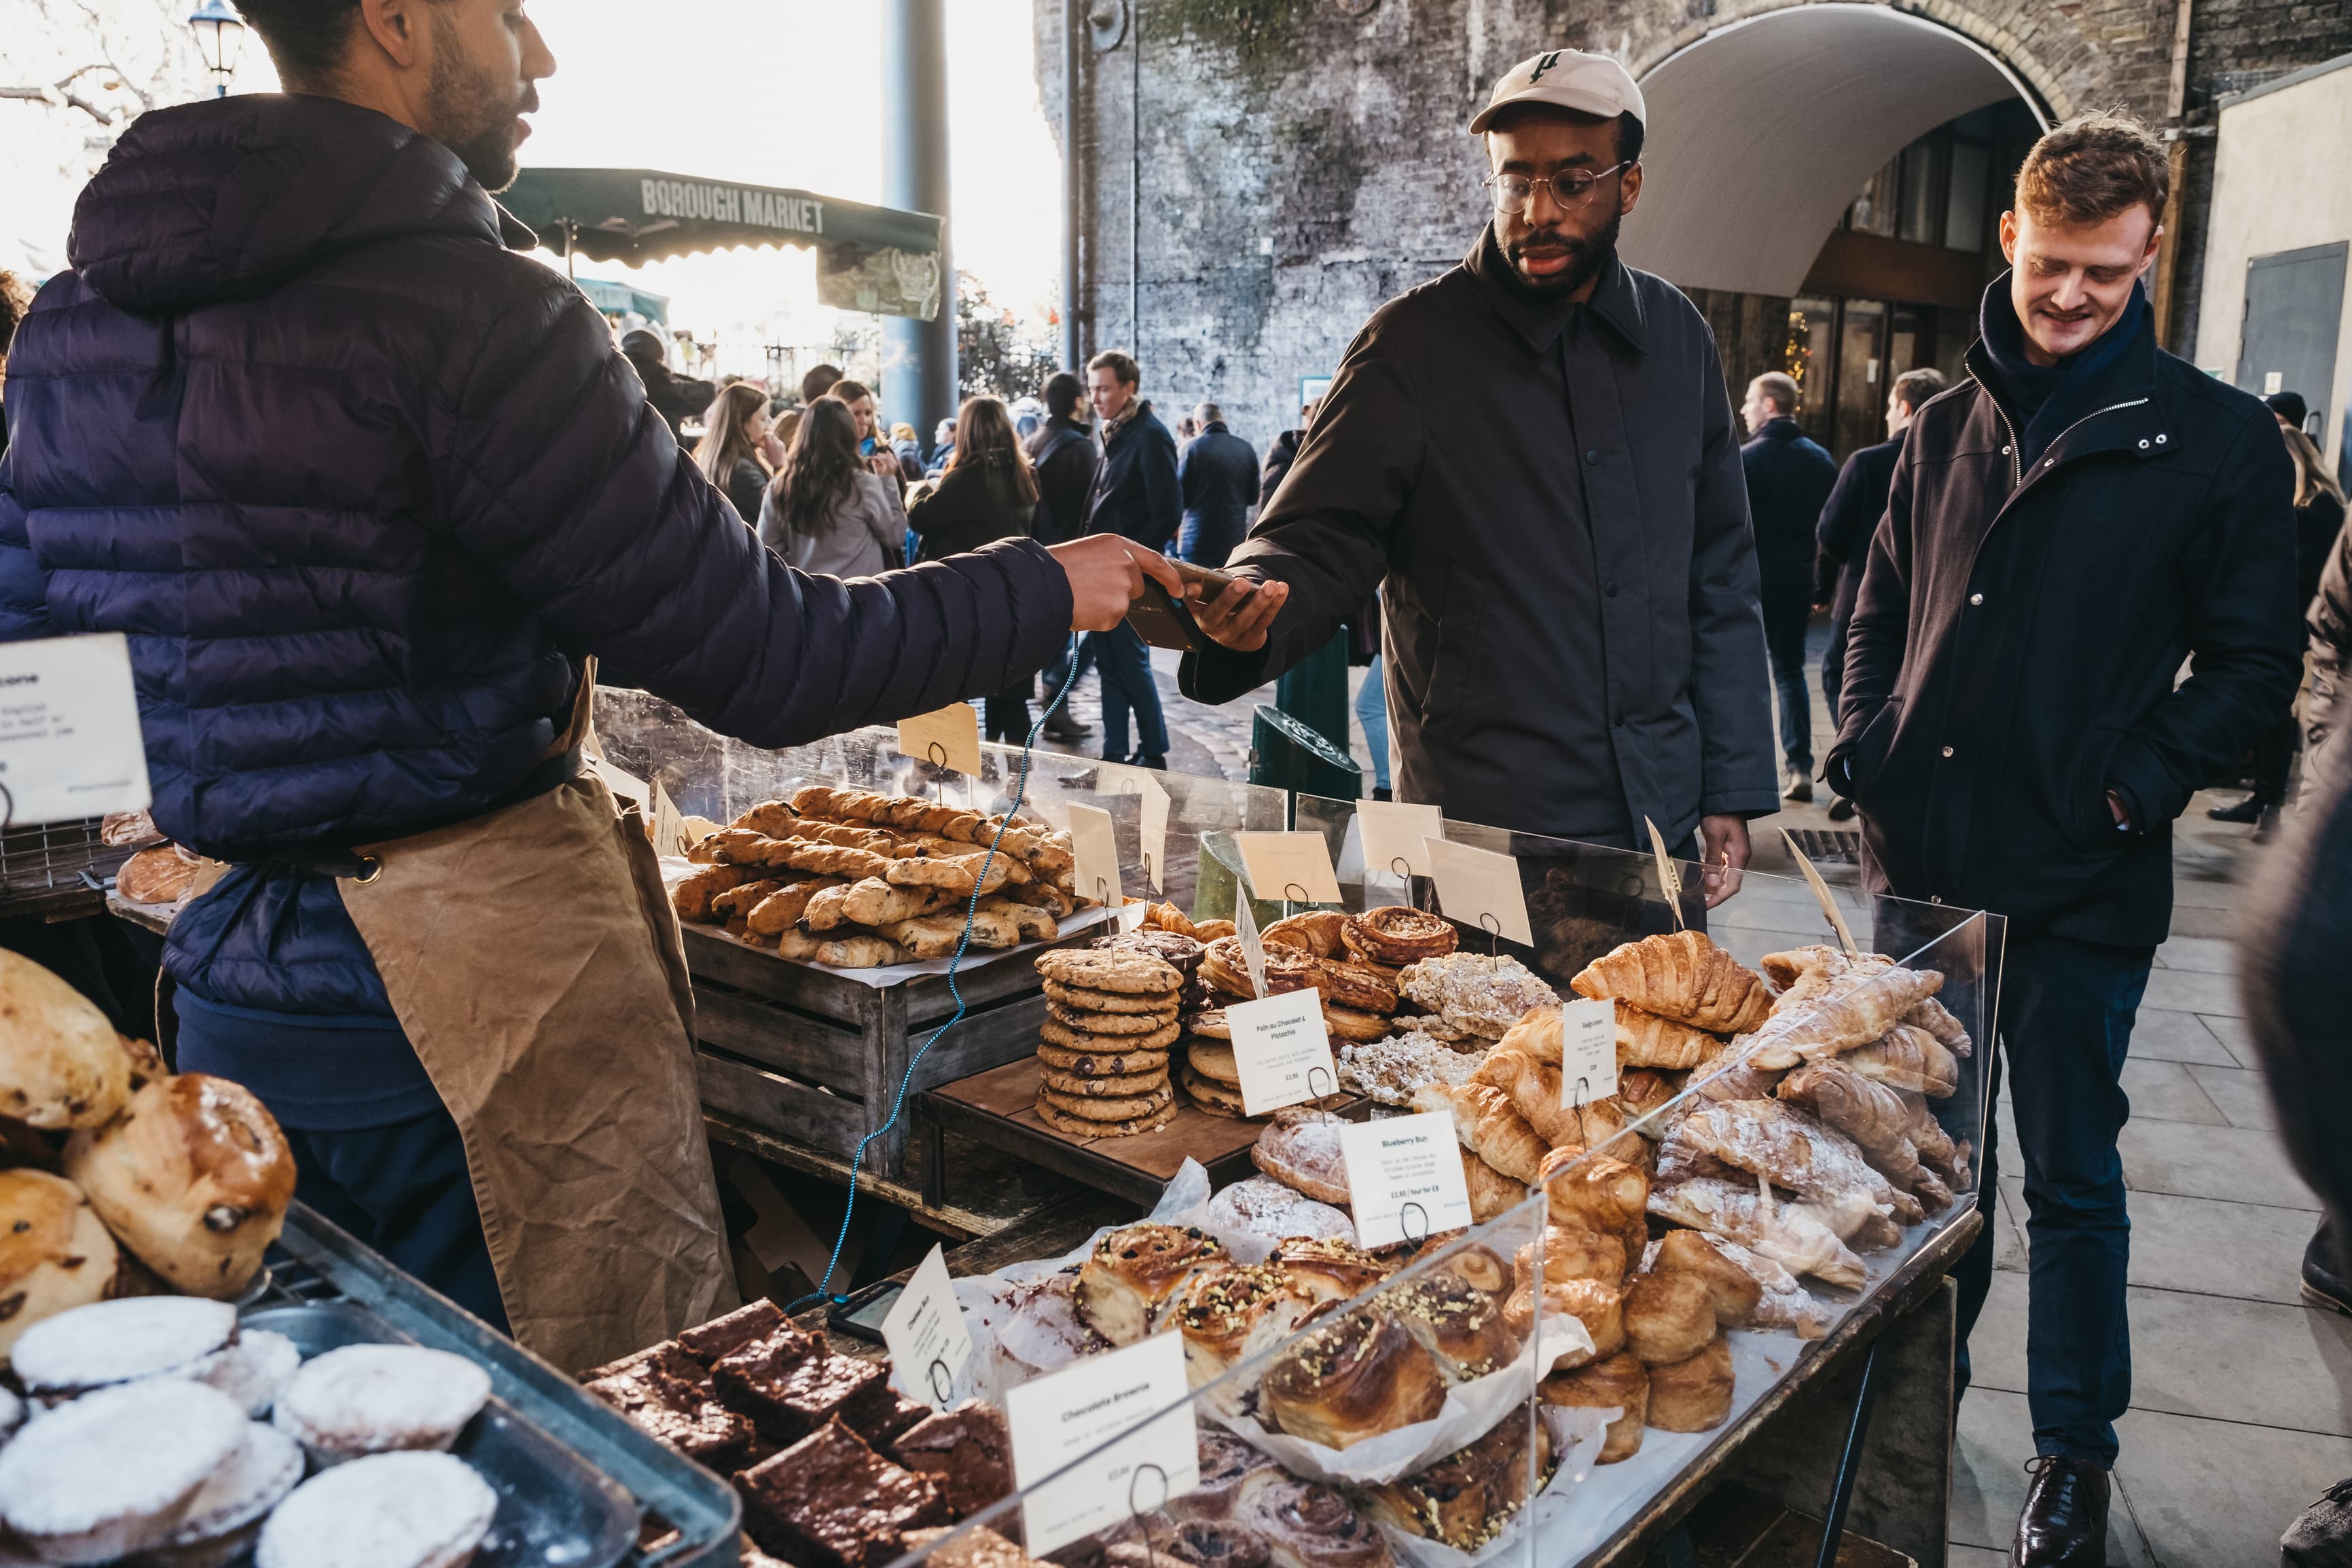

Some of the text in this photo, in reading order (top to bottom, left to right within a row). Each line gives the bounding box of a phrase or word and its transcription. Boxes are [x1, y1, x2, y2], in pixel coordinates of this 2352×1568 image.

[640, 179, 823, 234] BOROUGH MARKET
[1256, 1022, 1269, 1032] Pain
[1269, 1021, 1277, 1029] au
[1277, 1016, 1301, 1027] Chocolat
[1271, 1029, 1296, 1040] Pistachio
[1381, 1135, 1428, 1148] Blueberry Bun
[1062, 1383, 1150, 1423] Chocolate Brownie
